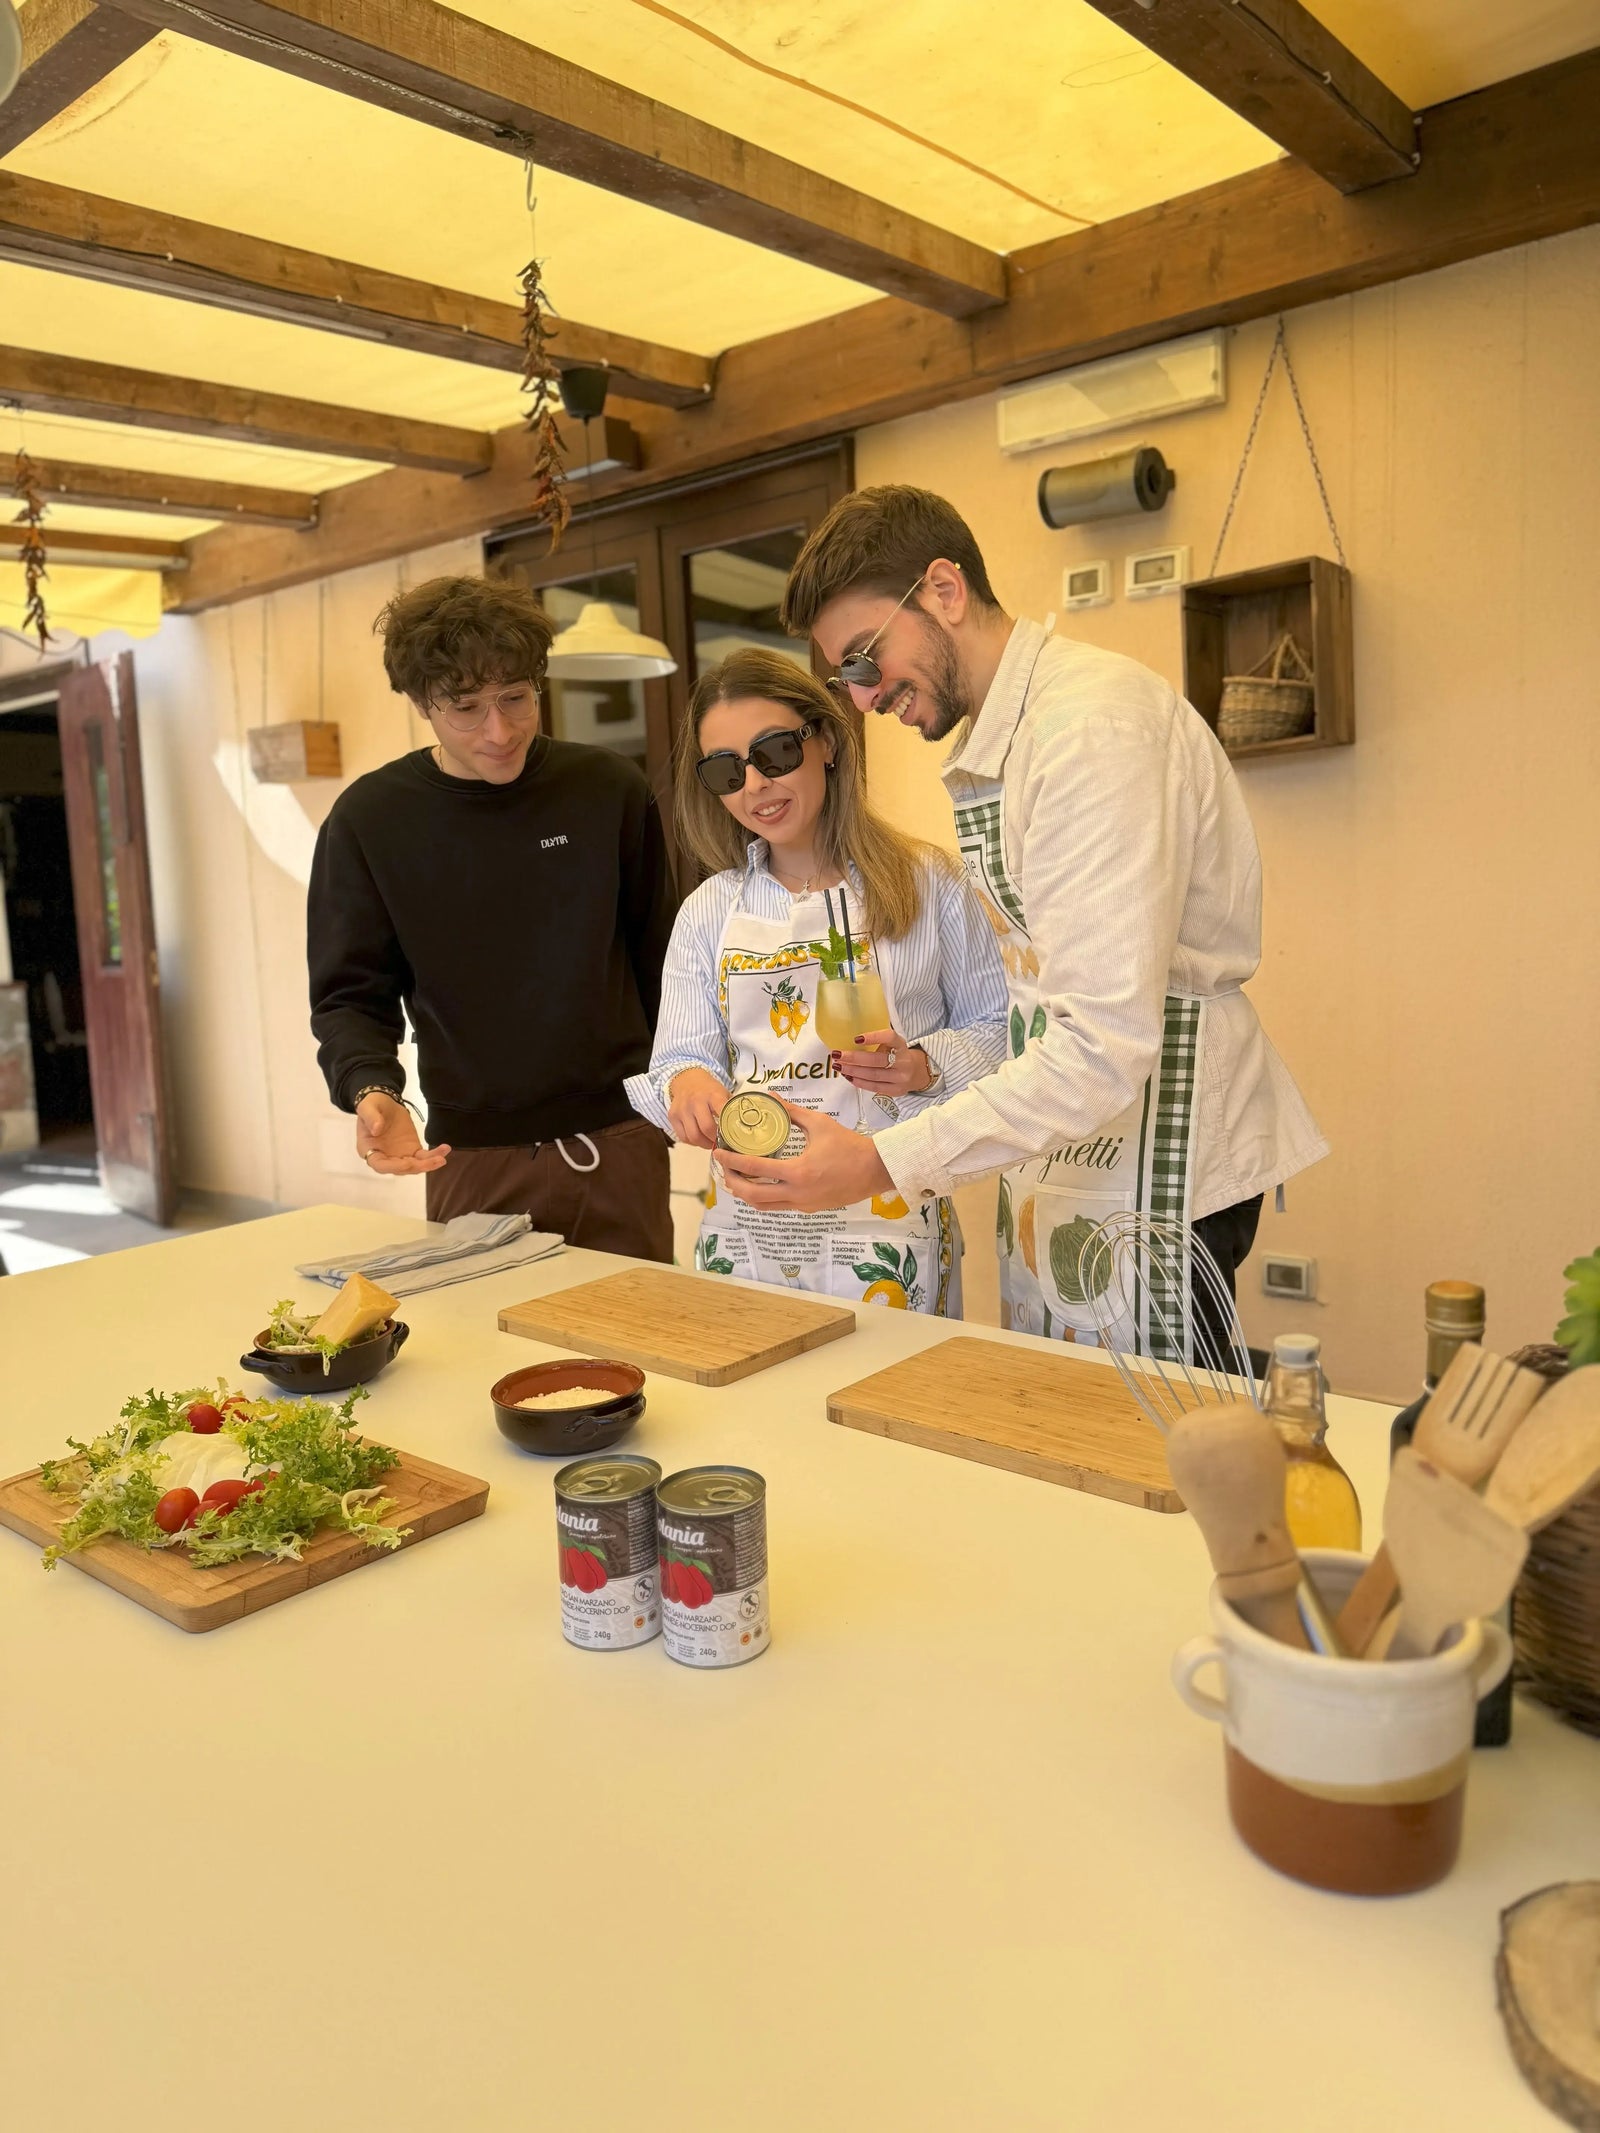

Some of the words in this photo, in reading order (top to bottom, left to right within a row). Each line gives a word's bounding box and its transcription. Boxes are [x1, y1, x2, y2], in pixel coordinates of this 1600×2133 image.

[579, 1599, 616, 1607] MARZANO
[613, 1605, 631, 1615] DOP
[683, 1614, 722, 1624] MARZANO
[719, 1621, 737, 1632] DOP
[594, 1630, 611, 1641] 240g
[699, 1647, 718, 1658] 240g
